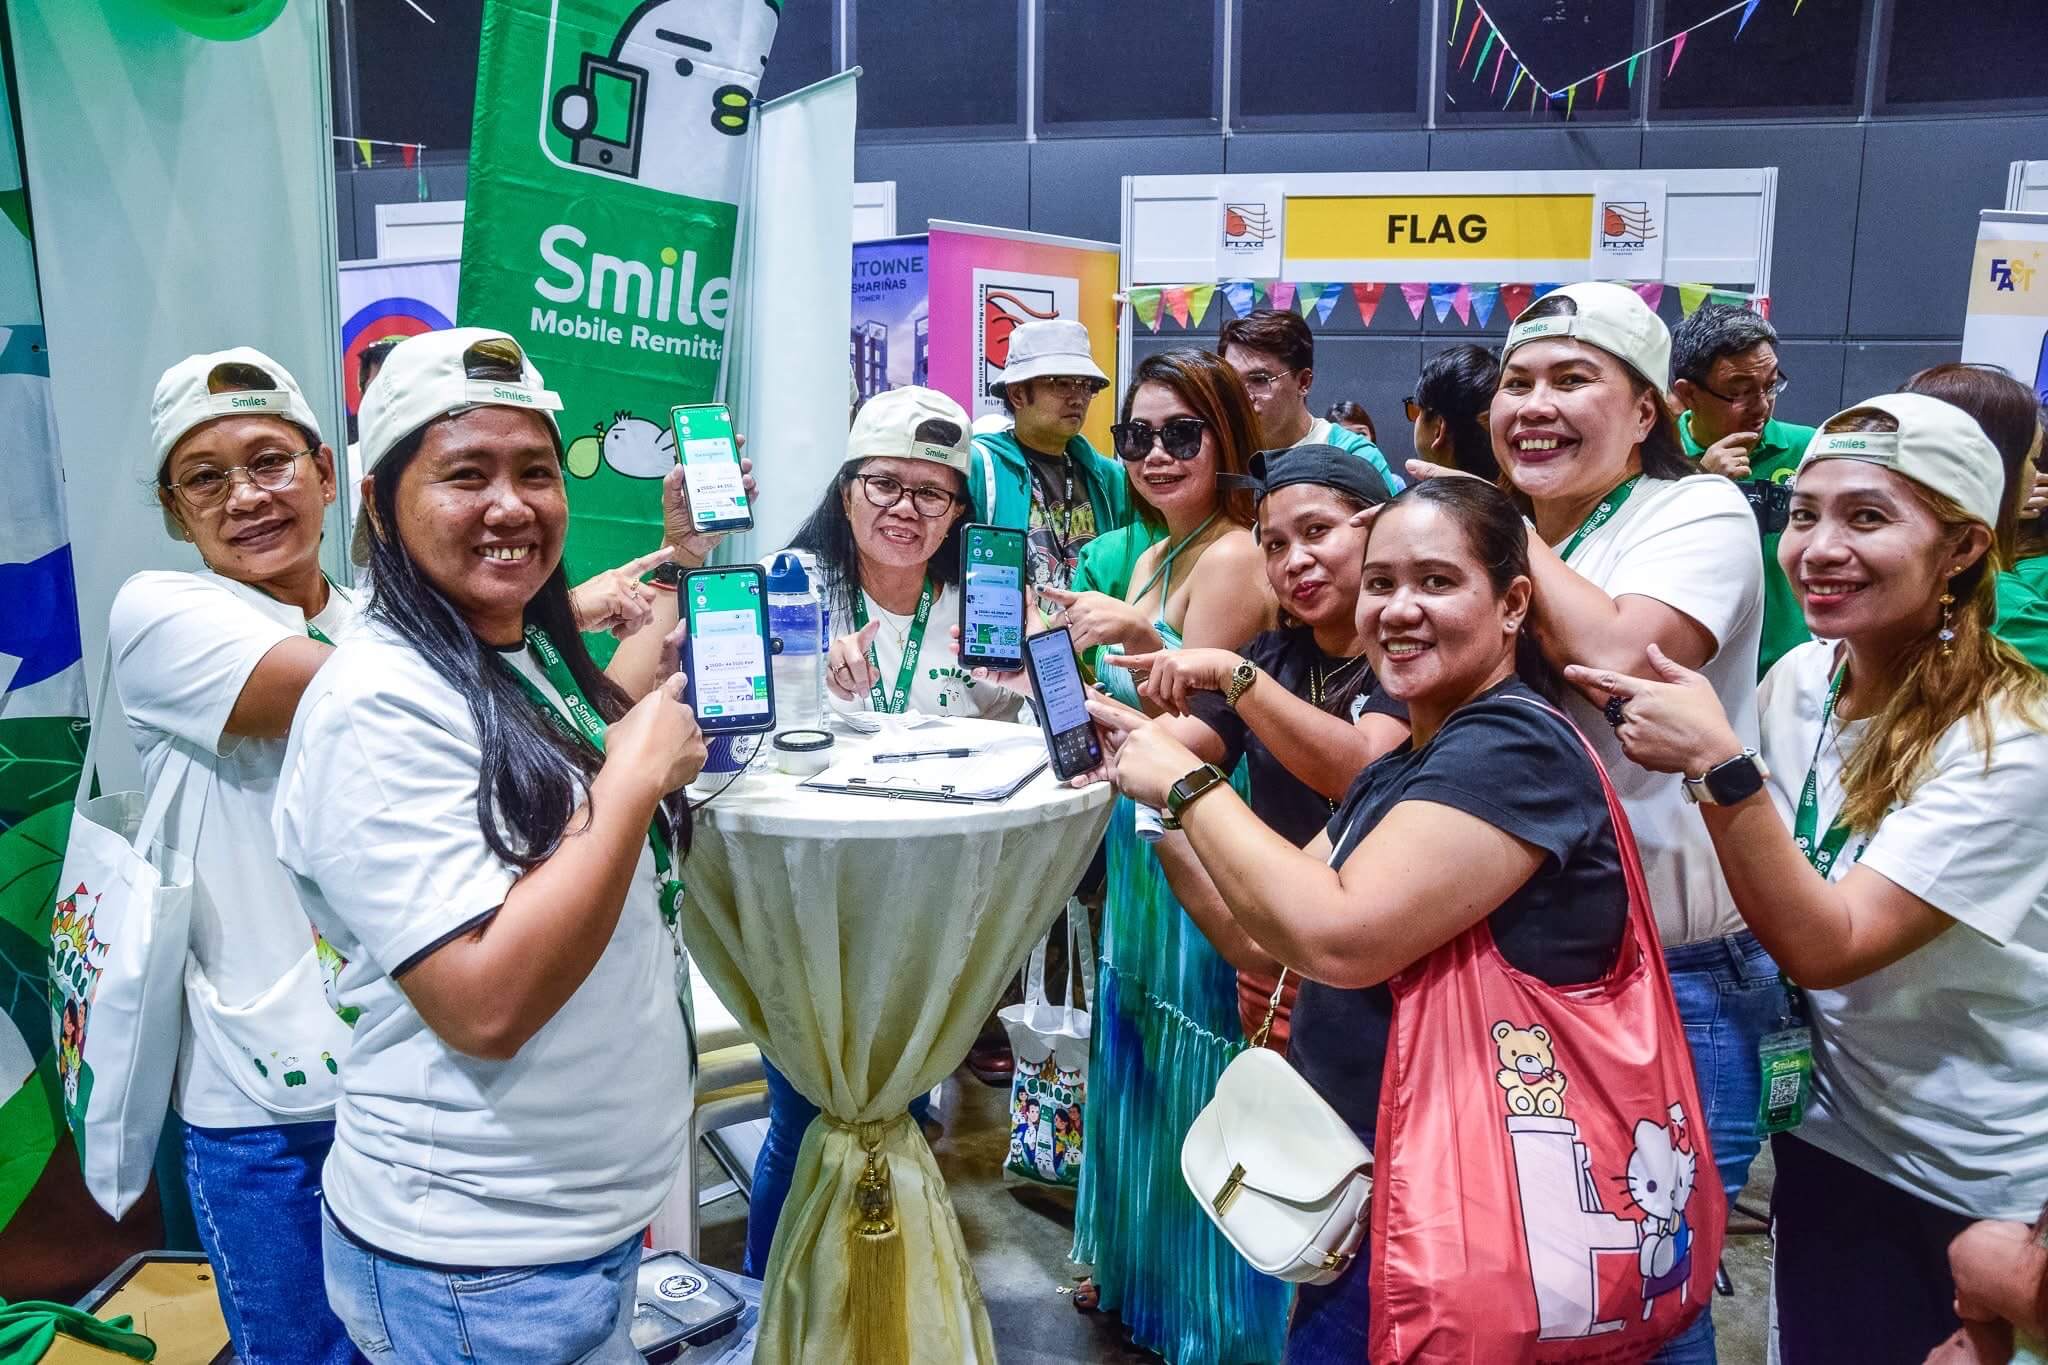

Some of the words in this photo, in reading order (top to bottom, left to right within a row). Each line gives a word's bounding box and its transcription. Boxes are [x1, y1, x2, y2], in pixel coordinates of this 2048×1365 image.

[1387, 214, 1488, 243] FLAG
[534, 224, 730, 331] Smile
[530, 307, 623, 345] Mobile
[1522, 322, 1549, 336] Smiles
[232, 396, 267, 408] Smiles
[494, 386, 533, 403] Smiles
[925, 447, 949, 460] Smiles
[1829, 438, 1867, 449] Smiles
[1580, 511, 1607, 538] Smiles
[918, 599, 930, 623] Smiles
[534, 630, 559, 665] Smiles
[905, 647, 918, 671] Smiles
[576, 703, 602, 735] Smiles
[1772, 1059, 1801, 1072] Smiles
